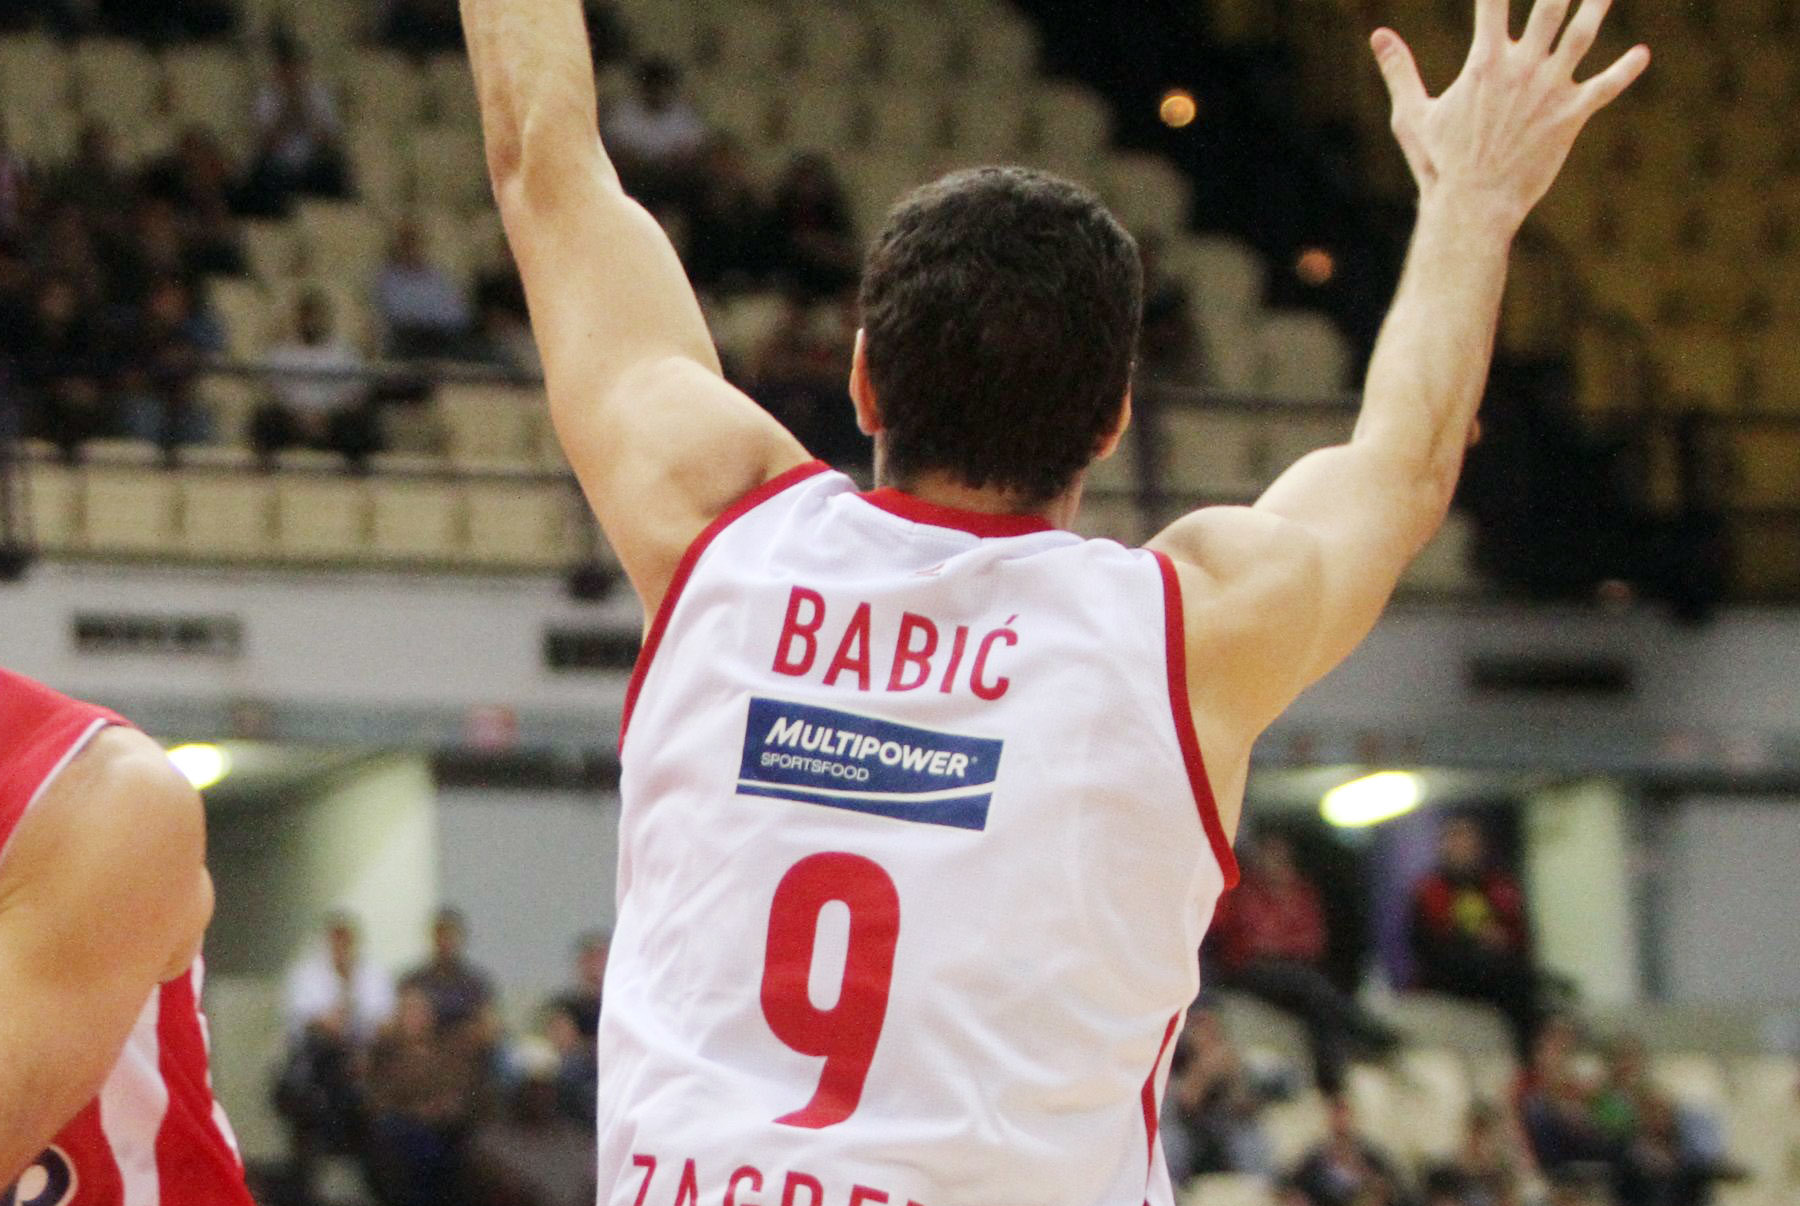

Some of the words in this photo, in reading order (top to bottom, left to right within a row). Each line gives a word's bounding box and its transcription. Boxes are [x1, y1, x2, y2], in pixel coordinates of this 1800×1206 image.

[772, 585, 1019, 701] BABIĆ
[760, 752, 870, 782] SPORTSFOOD
[764, 716, 970, 778] MULTIPOWER
[760, 851, 901, 1130] 9
